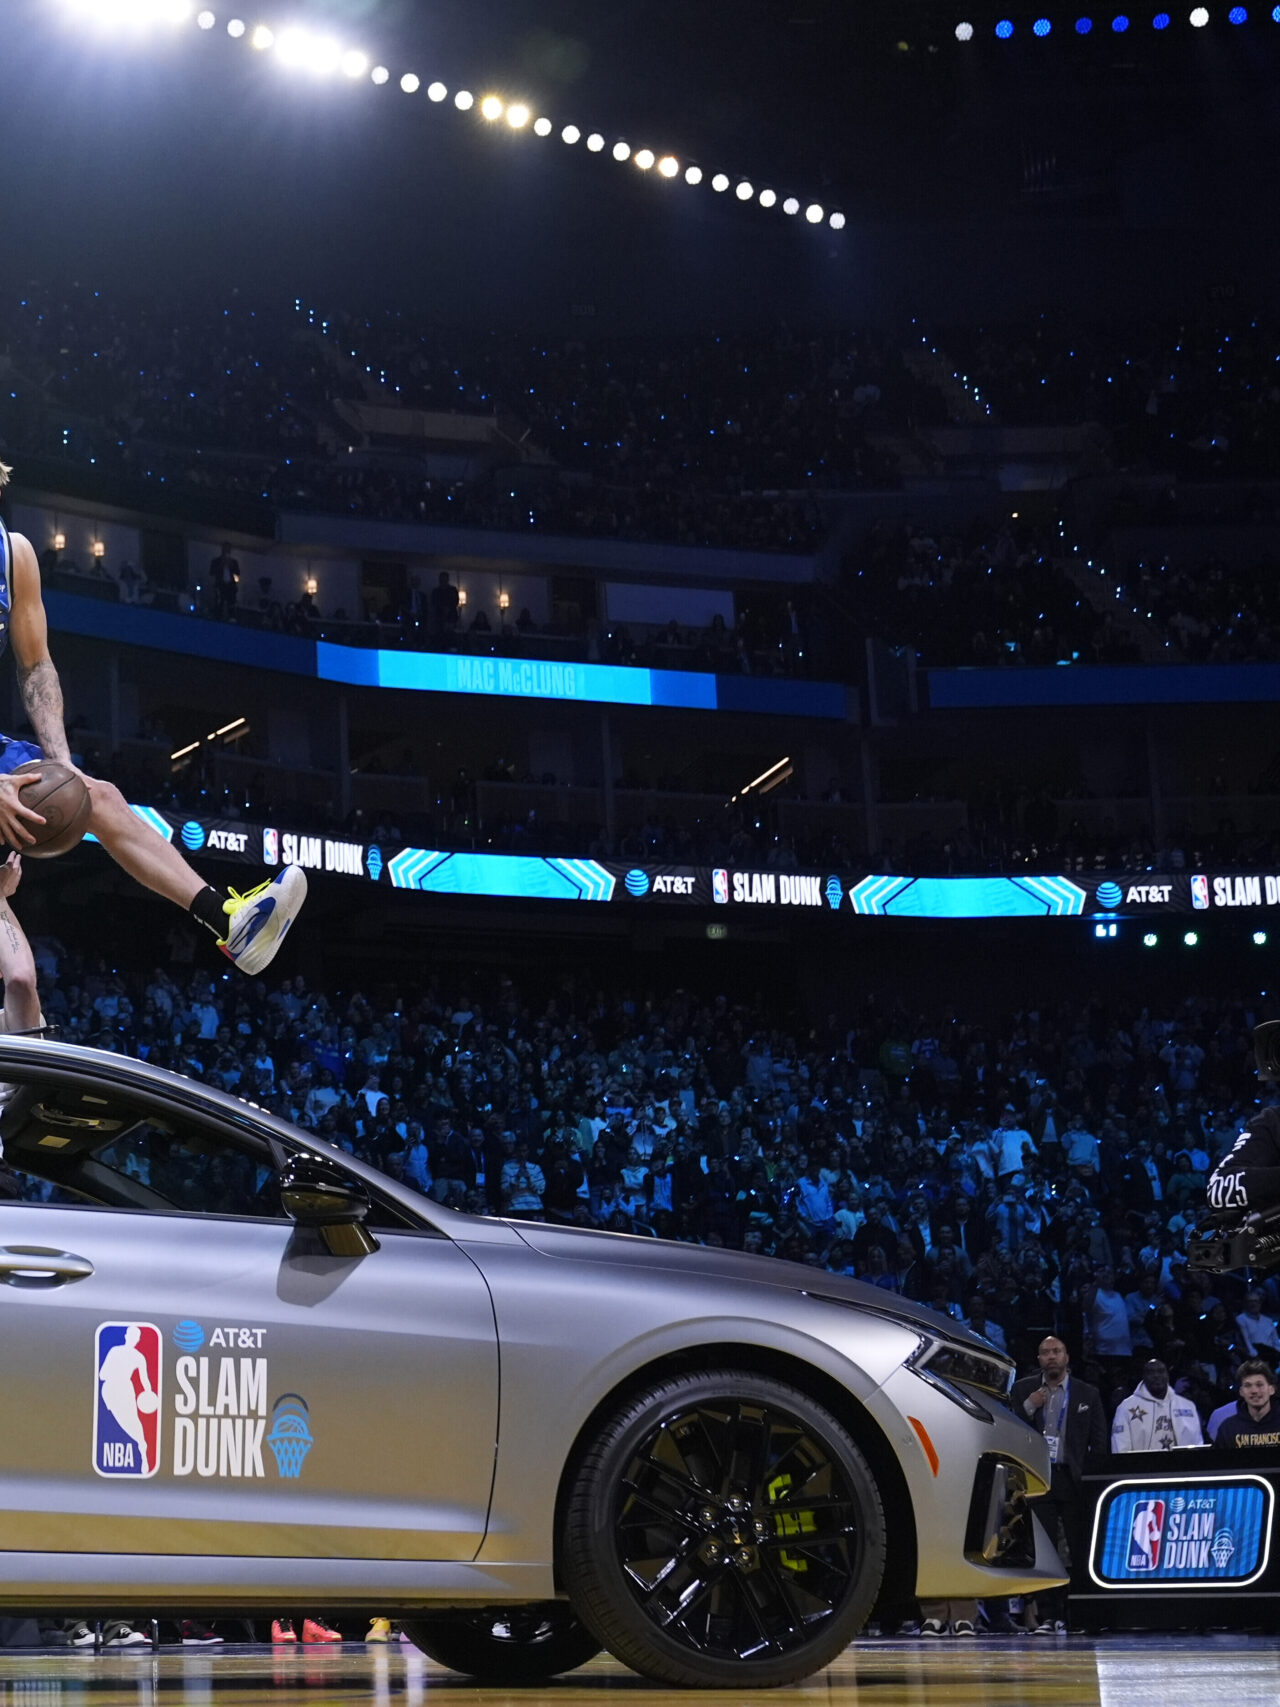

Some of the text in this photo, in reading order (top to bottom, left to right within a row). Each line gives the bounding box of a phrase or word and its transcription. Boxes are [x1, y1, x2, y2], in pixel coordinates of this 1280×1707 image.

[457, 659, 576, 696] MAC McCLUNG
[207, 829, 364, 876] AT&T SLAM DUNK
[652, 872, 822, 906] AT&T SLAM DUNK
[1126, 885, 1173, 903] AT&T
[1213, 876, 1262, 906] SLAM
[1207, 1171, 1248, 1208] 025
[209, 1327, 267, 1349] AT&T
[175, 1355, 268, 1417] SLAM
[103, 1442, 135, 1468] NBA
[173, 1417, 267, 1477] DUNK
[1235, 1433, 1250, 1448] SAN
[1187, 1499, 1217, 1510] AT&T
[1167, 1512, 1215, 1541] SLAM
[1130, 1554, 1147, 1567] NBA
[1163, 1540, 1212, 1569] DUNK
